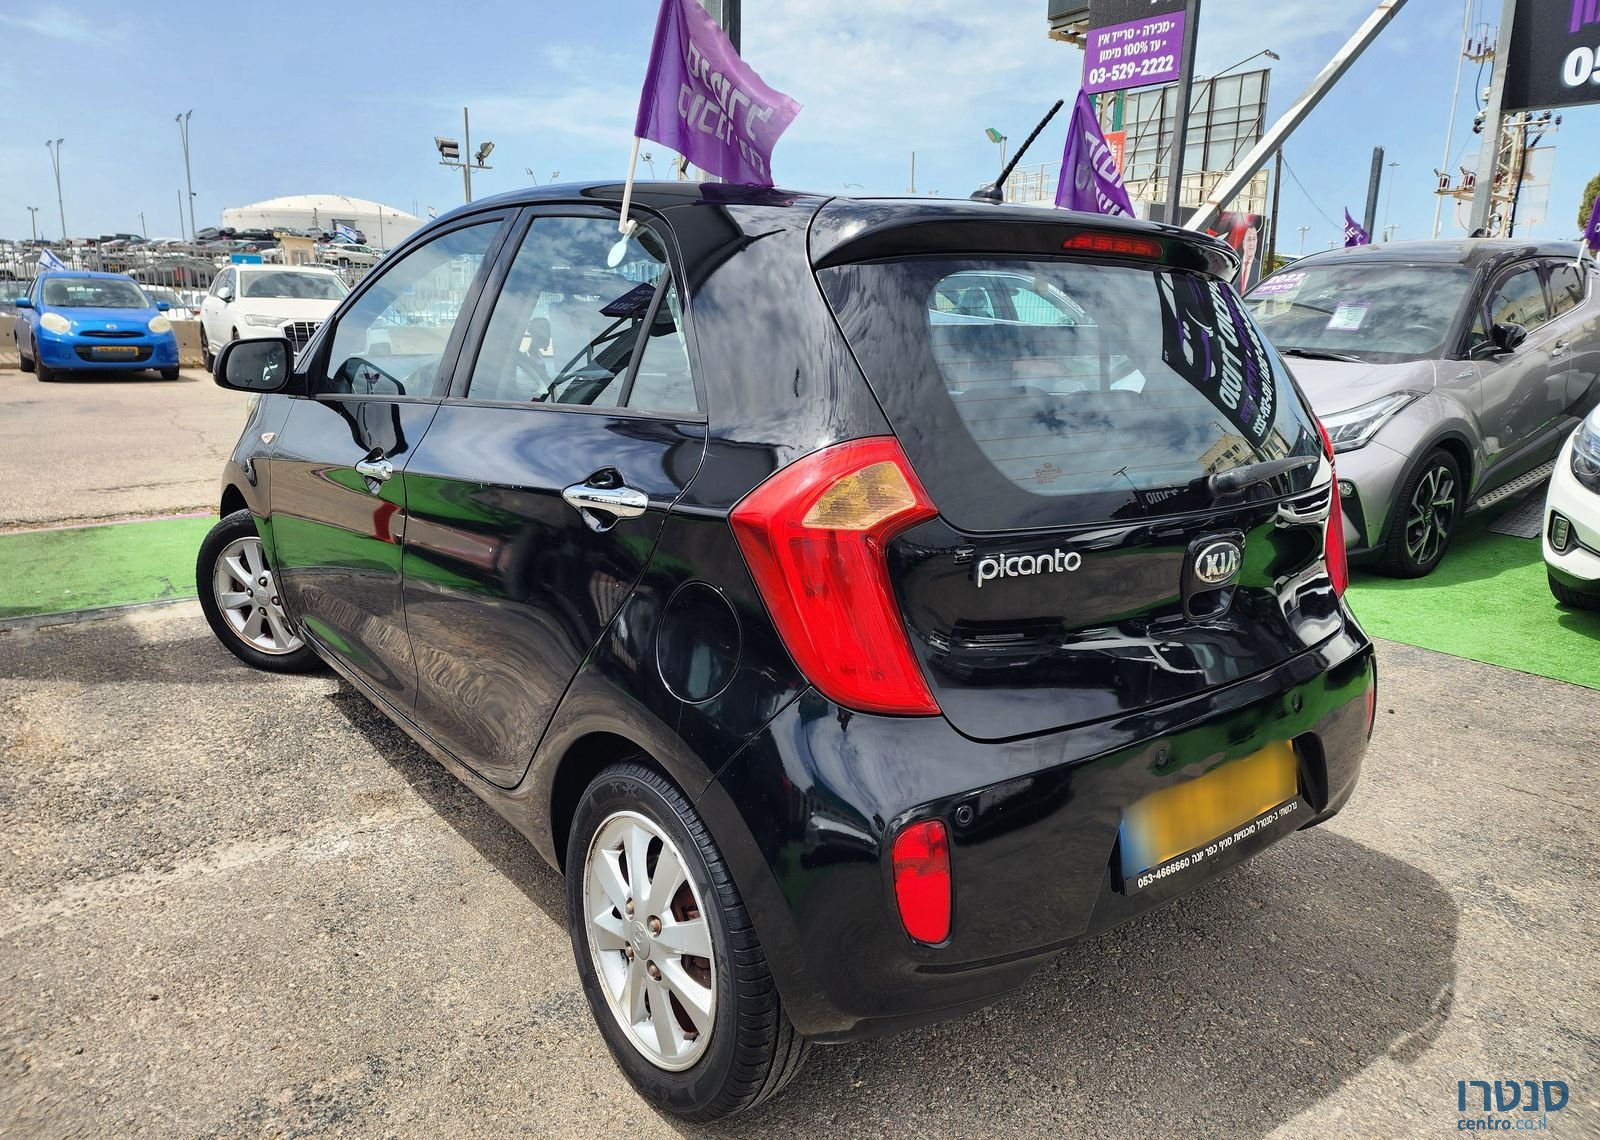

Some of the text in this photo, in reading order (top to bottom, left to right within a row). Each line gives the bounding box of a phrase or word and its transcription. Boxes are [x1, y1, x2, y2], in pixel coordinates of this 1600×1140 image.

[1098, 21, 1170, 48] מכירה טרייד אין
[1099, 40, 1161, 63] עד 100% מימון
[1089, 55, 1174, 85] 03-529-2222
[1564, 46, 1600, 86] 0
[977, 548, 1082, 588] picanto
[1205, 550, 1238, 576] KIA
[1204, 844, 1218, 857] כפר
[1218, 836, 1233, 851] סניף
[1191, 851, 1204, 864] יונה
[1137, 857, 1190, 889] 053-4666660
